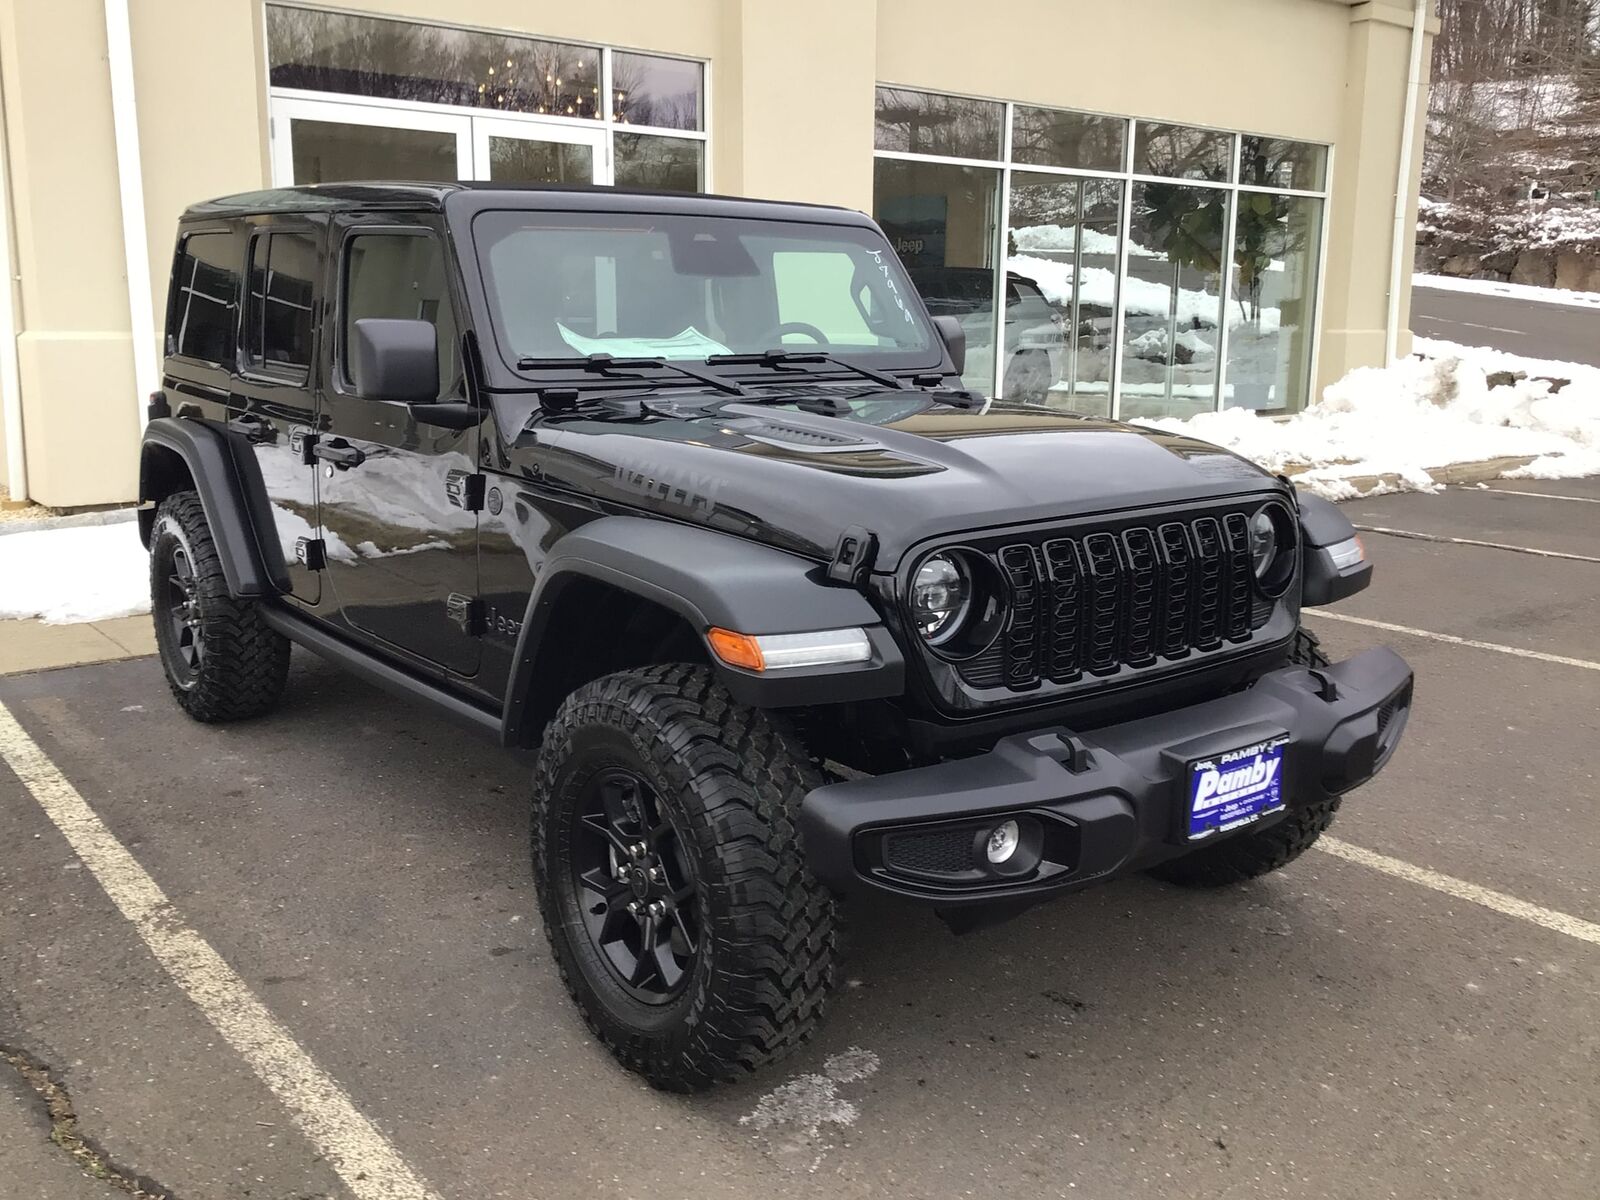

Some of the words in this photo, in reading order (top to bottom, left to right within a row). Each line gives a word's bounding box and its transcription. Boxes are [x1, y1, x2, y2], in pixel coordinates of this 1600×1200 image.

[894, 237, 924, 254] Jeep
[485, 606, 523, 636] Jee
[1192, 754, 1281, 812] Pamby
